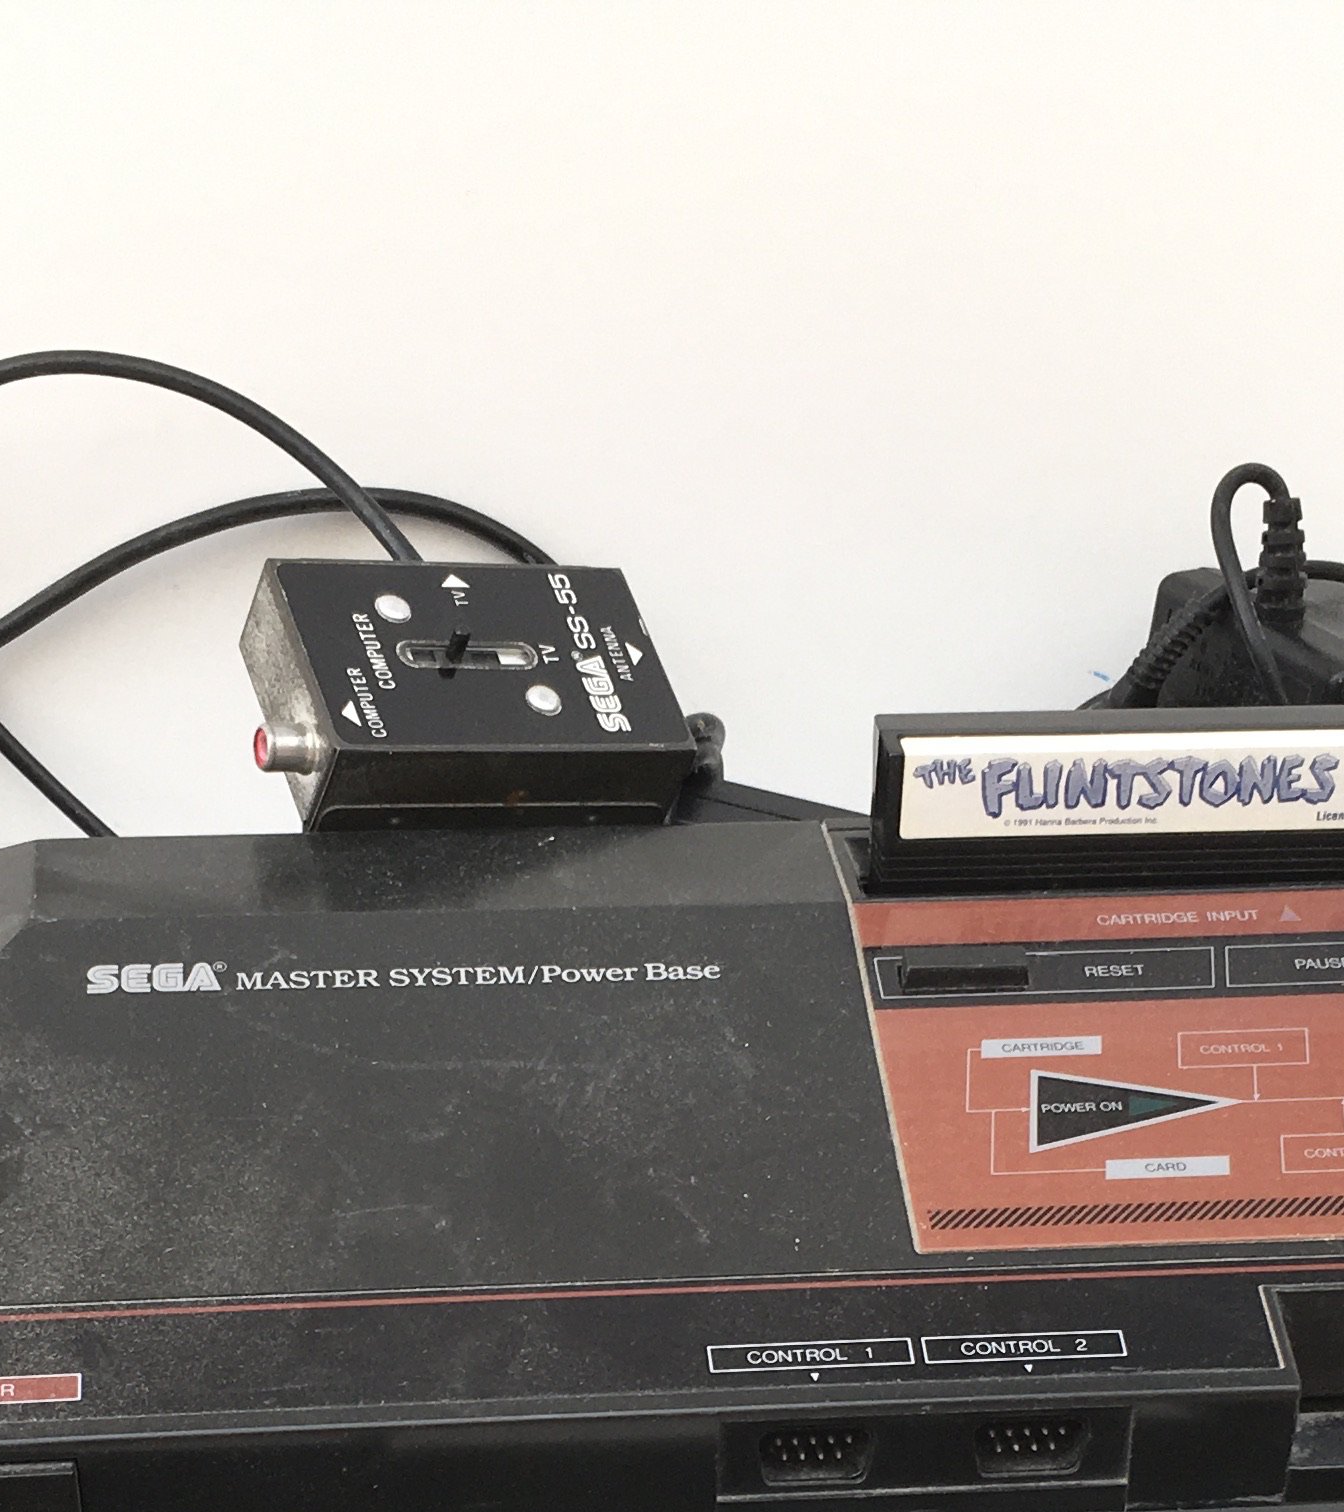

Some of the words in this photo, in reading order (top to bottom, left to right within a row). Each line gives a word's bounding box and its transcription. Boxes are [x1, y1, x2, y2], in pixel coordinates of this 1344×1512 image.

[451, 589, 470, 607] TV
[547, 573, 596, 650] SS-55
[353, 612, 396, 690] COMPUTER
[538, 644, 560, 664] TV
[601, 625, 634, 682] ANTENNA
[348, 667, 387, 738] COMPUTER
[575, 655, 631, 733] SEGA
[913, 757, 975, 788] THE
[981, 753, 1338, 819] FLINTSTONES
[1096, 909, 1198, 925] CARTRIDGE
[1206, 907, 1258, 923] INPUT
[86, 963, 221, 994] SEGA
[236, 969, 380, 991] MASTER
[645, 962, 721, 981] Base
[1083, 962, 1143, 979] RESET
[1001, 1040, 1084, 1053] CARTRIDGE
[1199, 1042, 1270, 1055] CONTROL
[1276, 1042, 1284, 1052] 1
[1040, 1100, 1096, 1115] POWER
[1100, 1099, 1123, 1112] ON
[1144, 1160, 1187, 1174] CARD
[746, 1347, 847, 1364] CONTROL
[865, 1346, 874, 1359] 1
[960, 1339, 1060, 1356] CONTROL
[1074, 1338, 1089, 1352] 2
